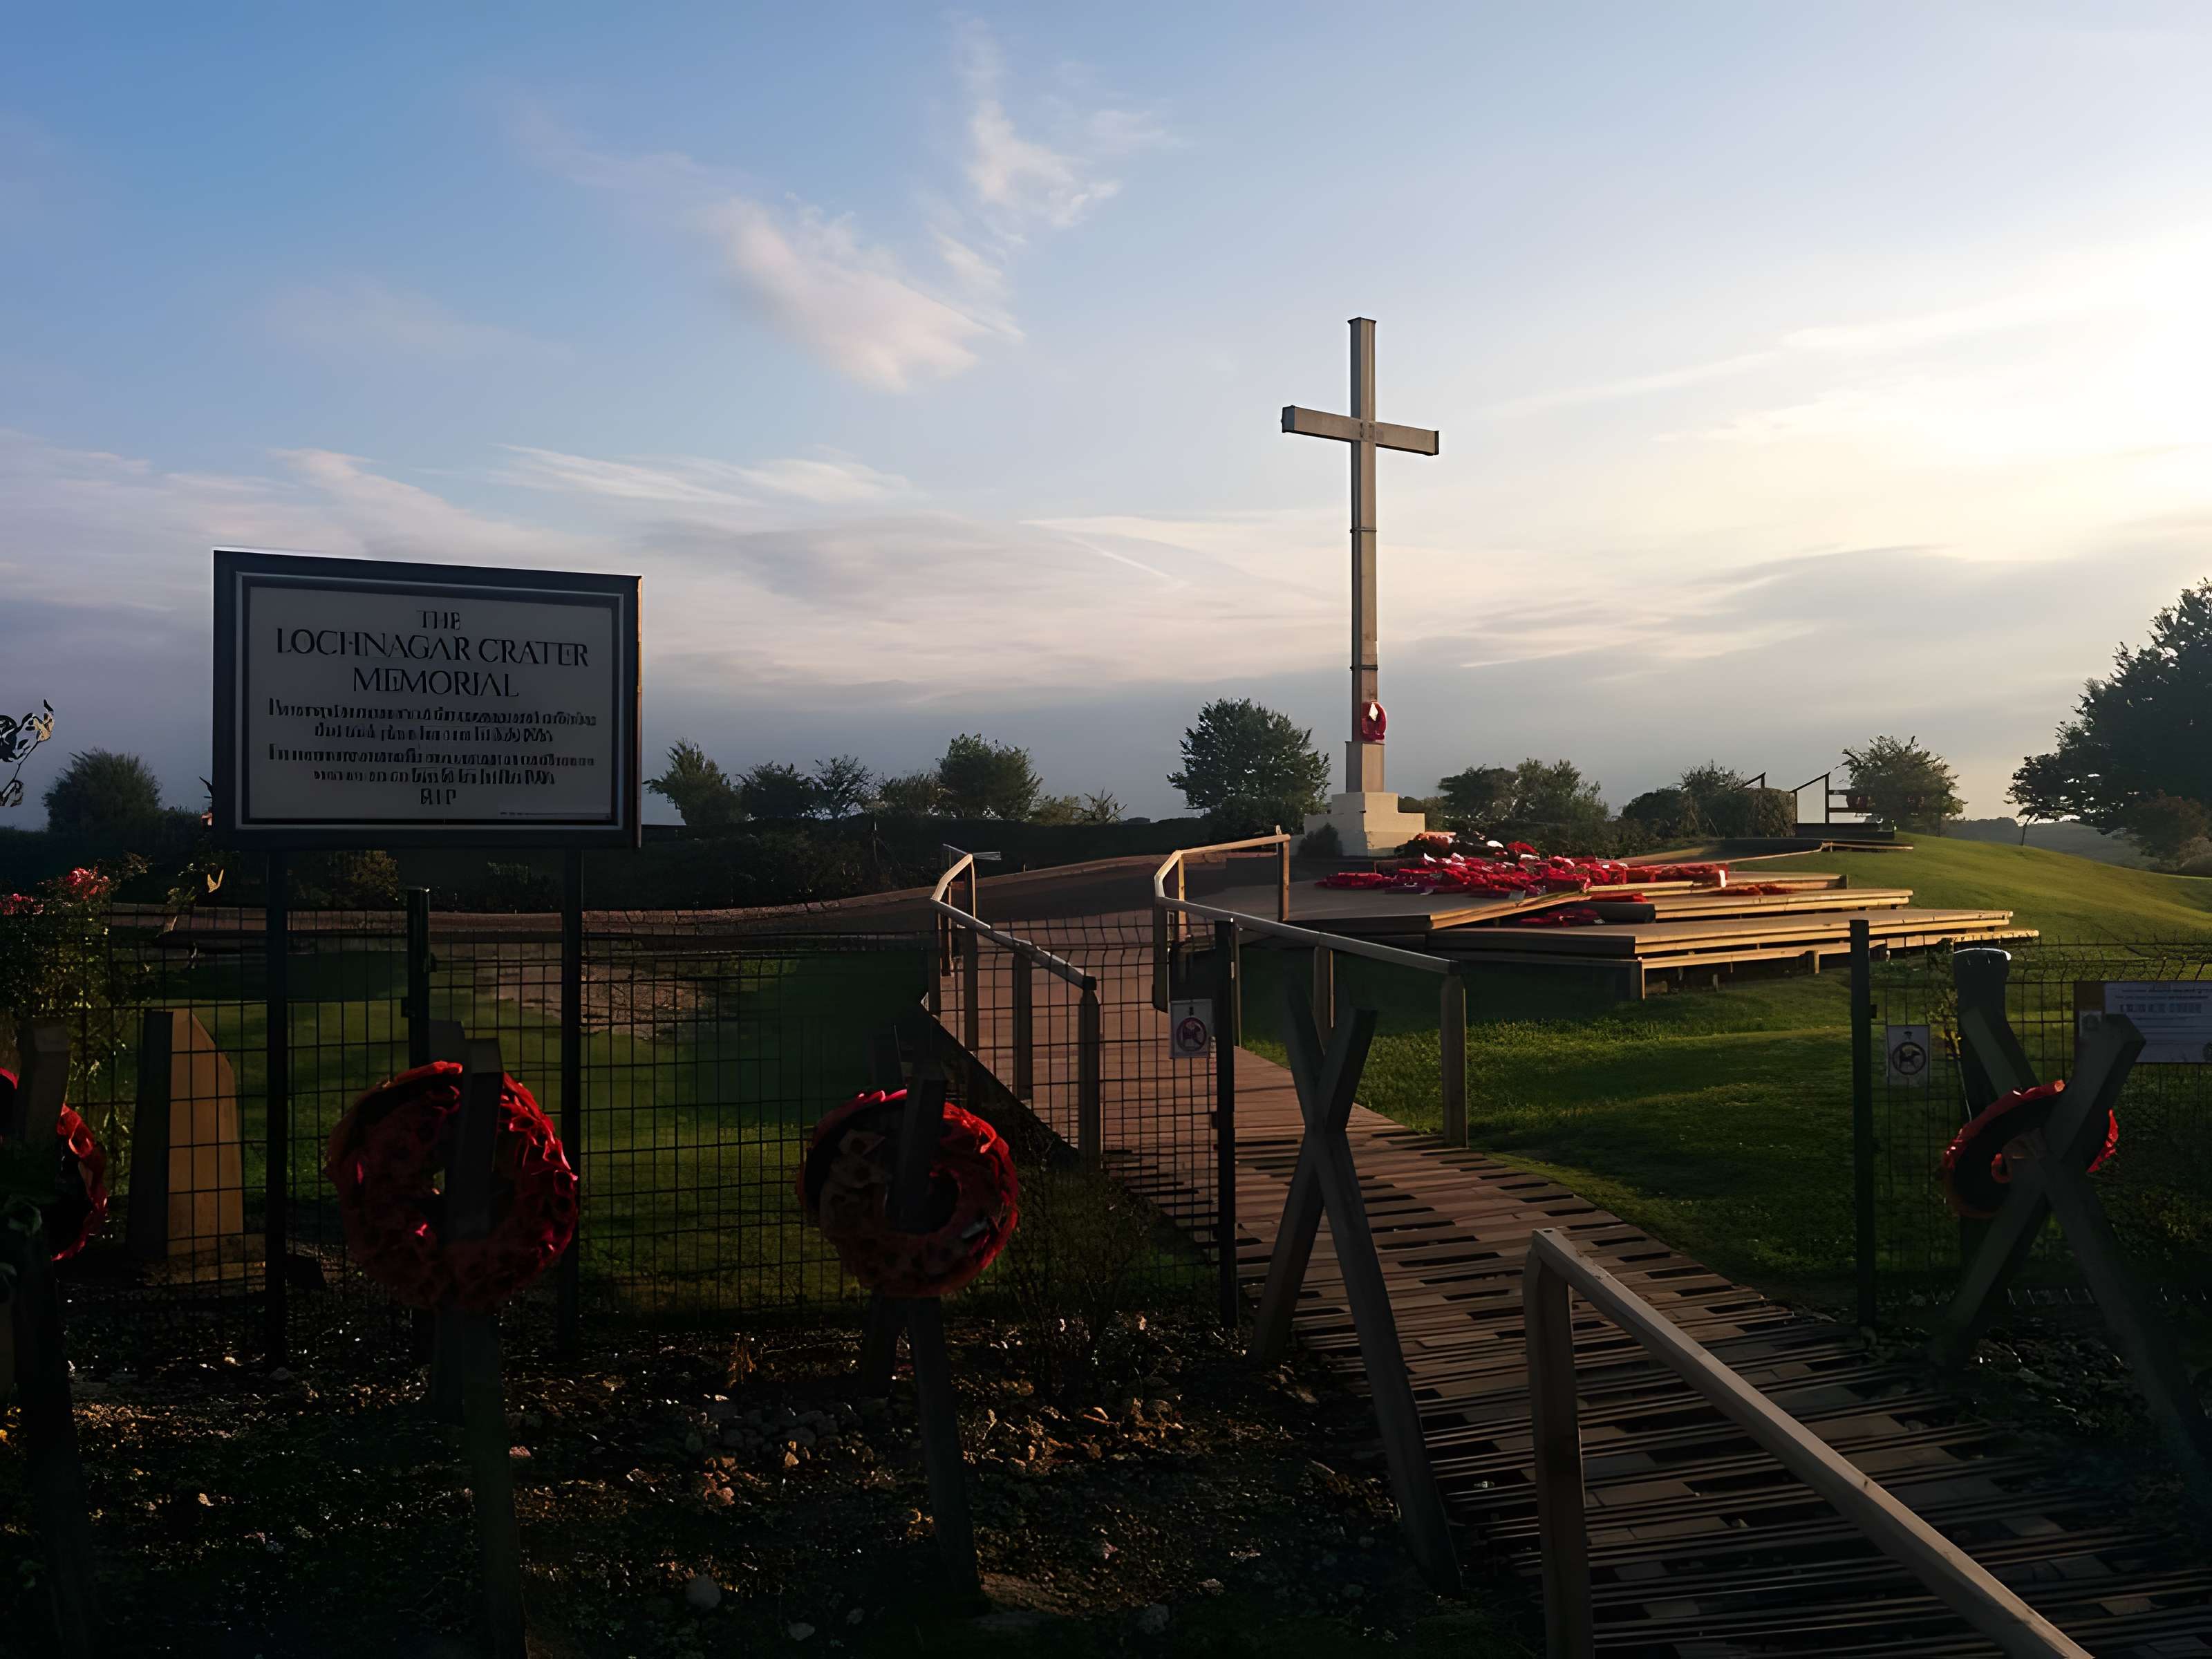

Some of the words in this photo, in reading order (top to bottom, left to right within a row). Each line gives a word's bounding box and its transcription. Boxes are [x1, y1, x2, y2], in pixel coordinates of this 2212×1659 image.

[416, 610, 462, 630] THE
[276, 627, 471, 662] LOCHNAGAR
[478, 637, 590, 668] CRATER
[353, 666, 520, 697] MEMORIAL
